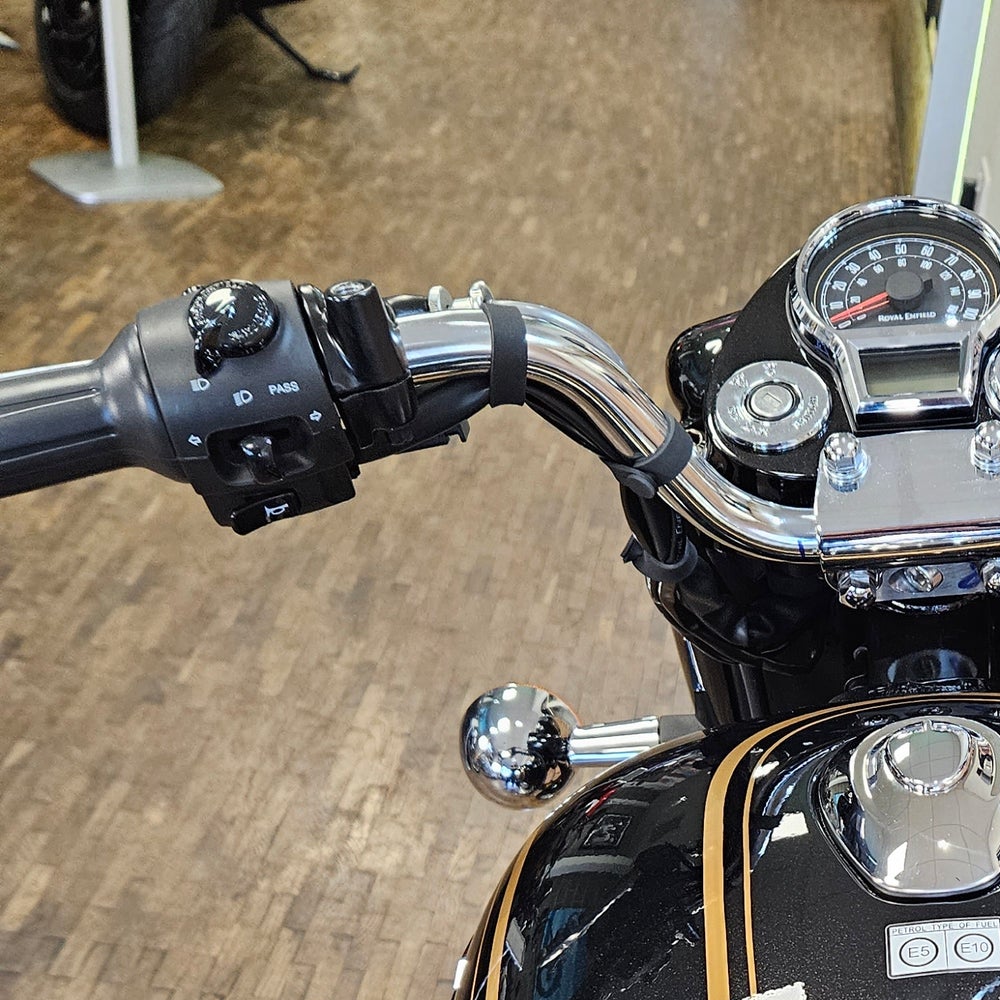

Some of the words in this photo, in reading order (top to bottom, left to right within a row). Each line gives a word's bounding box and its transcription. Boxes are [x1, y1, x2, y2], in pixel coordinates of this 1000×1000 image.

[868, 248, 882, 261] 40
[895, 243, 907, 255] 50
[920, 245, 935, 257] 60
[944, 253, 959, 266] 70
[845, 261, 861, 275] 30
[832, 280, 847, 292] 20
[878, 313, 904, 322] ROYAL
[904, 311, 937, 321] ENFIELD
[268, 380, 300, 396] PASS
[892, 925, 927, 935] PETROL
[931, 923, 953, 931] TYPE
[958, 921, 972, 929] OF
[976, 920, 998, 928] FUEL
[908, 945, 930, 958] E5
[960, 941, 989, 954] E10
